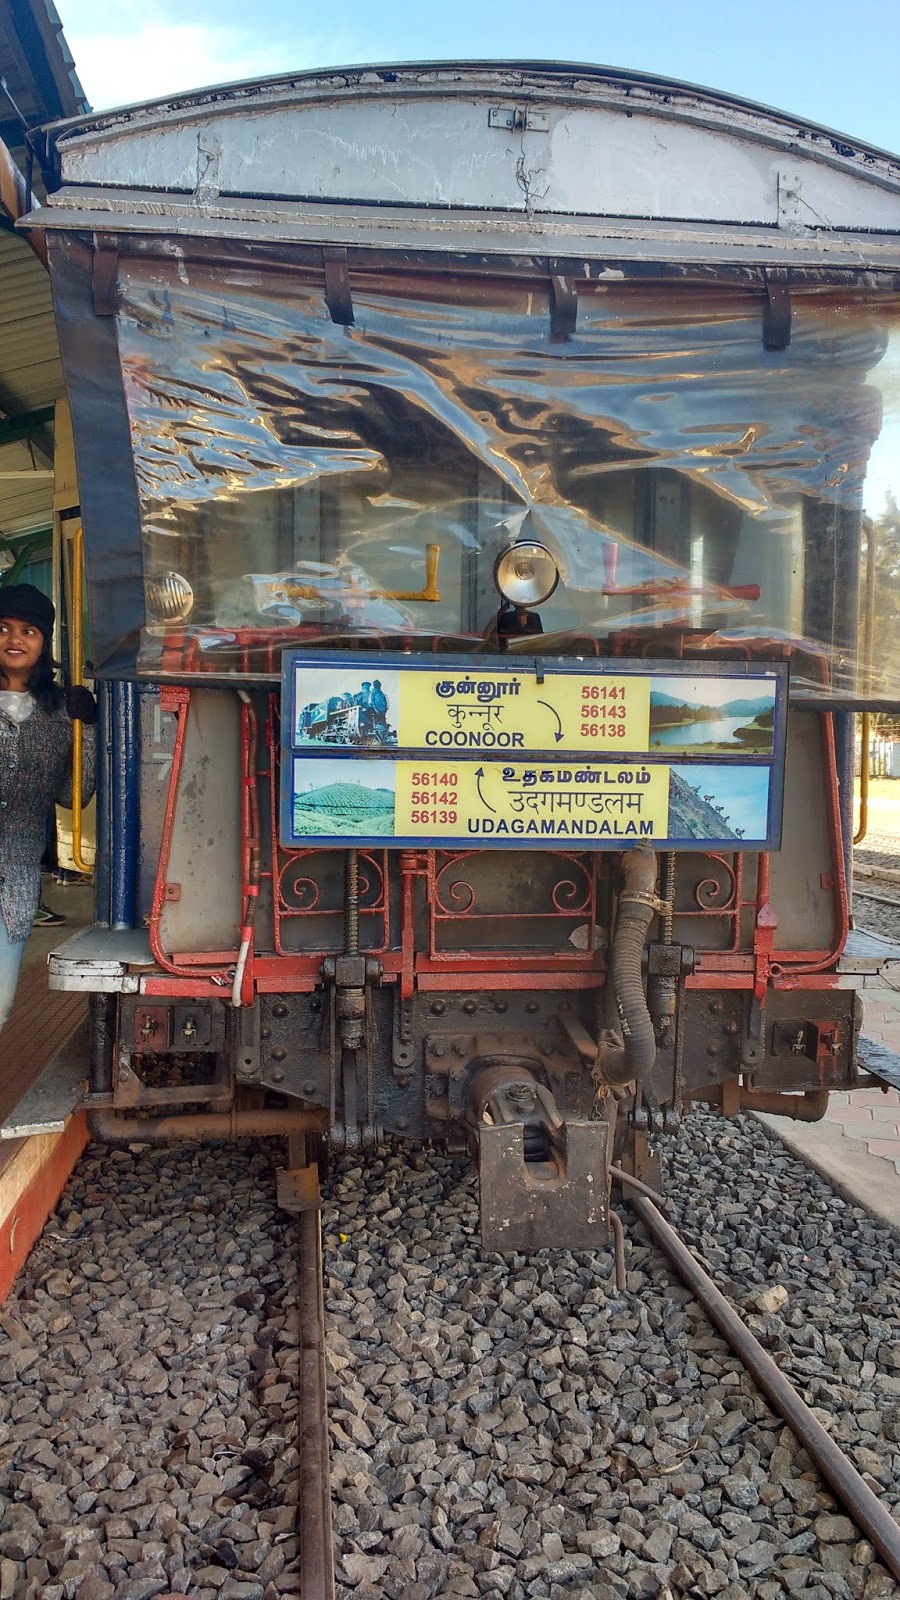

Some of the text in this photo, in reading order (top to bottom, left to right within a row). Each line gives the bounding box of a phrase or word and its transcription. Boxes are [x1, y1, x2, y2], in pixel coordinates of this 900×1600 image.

[435, 675, 522, 702] குன்னூர்
[580, 685, 627, 700] 56141
[446, 703, 505, 731] कुन्नूर
[580, 704, 627, 719] 56143
[580, 723, 626, 738] 56138
[425, 730, 525, 748] COONOOR
[411, 772, 458, 787] 56140
[501, 765, 651, 787] உதகமண்டலம்
[411, 791, 458, 806] 56142
[507, 790, 644, 815] उदगमण्डलम
[410, 810, 458, 824] 56139
[467, 818, 654, 835] UDAGAMANDALAM
